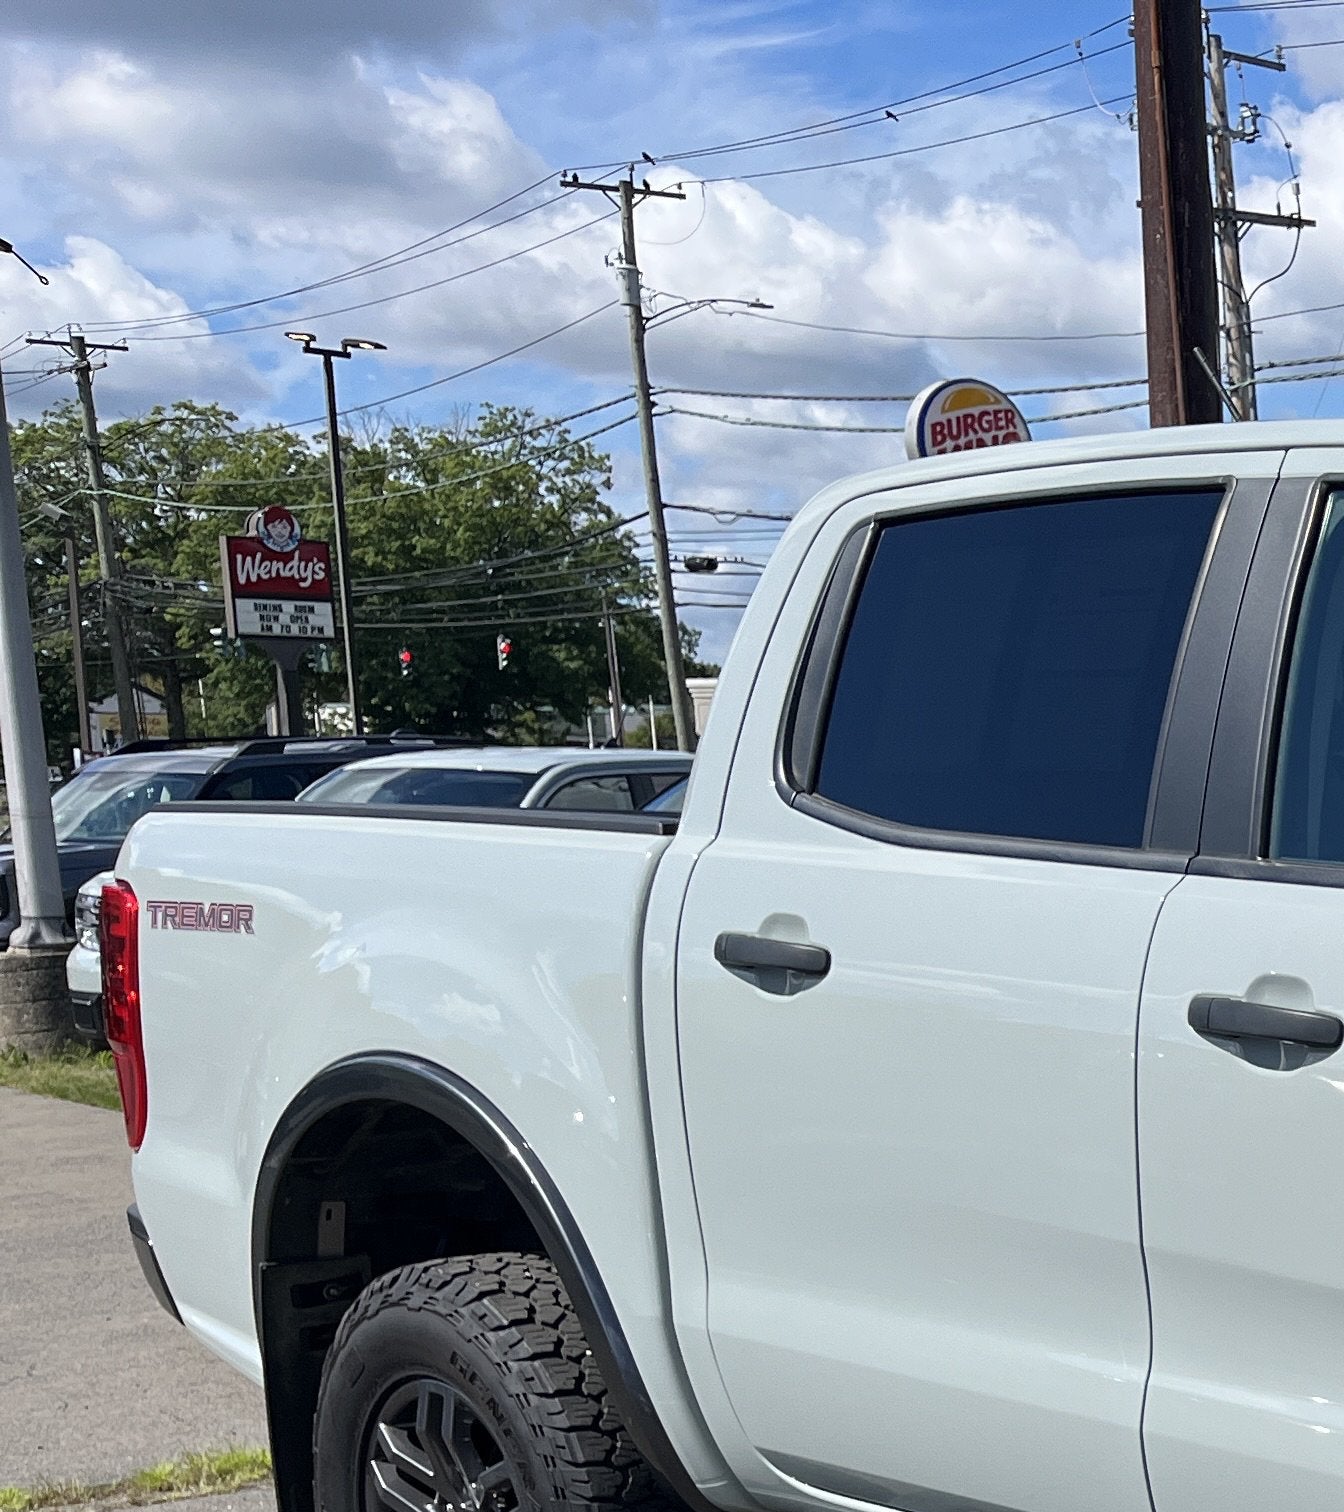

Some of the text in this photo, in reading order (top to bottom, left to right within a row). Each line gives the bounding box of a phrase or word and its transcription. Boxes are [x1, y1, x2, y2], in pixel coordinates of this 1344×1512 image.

[931, 408, 1017, 448] BURGER
[236, 550, 326, 588] Wendy's
[147, 901, 254, 935] TREMOR
